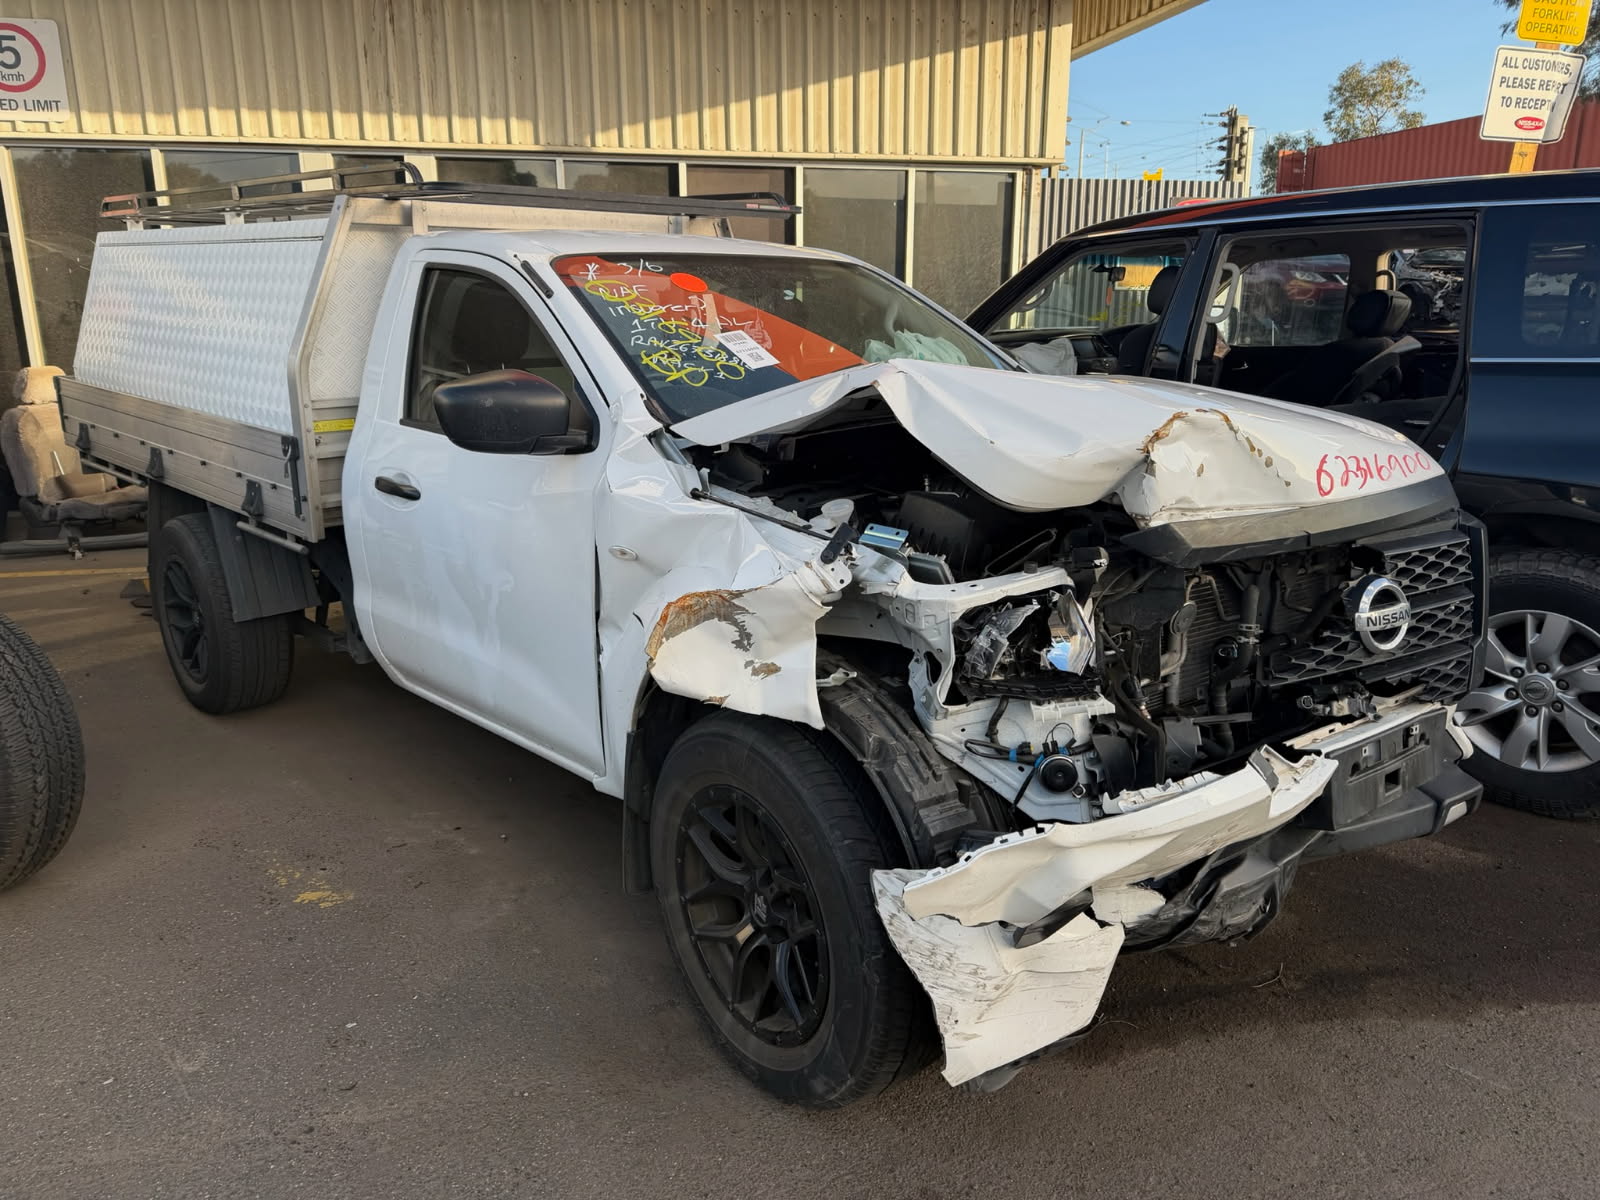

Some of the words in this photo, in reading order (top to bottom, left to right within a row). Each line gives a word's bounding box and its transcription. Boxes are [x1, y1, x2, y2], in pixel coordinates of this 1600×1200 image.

[1525, 21, 1580, 36] OPERATING
[1502, 56, 1520, 70] ALL
[1521, 58, 1572, 77] CUSTOMRS,
[1500, 76, 1537, 91] PLEASE
[1538, 79, 1568, 95] REPRT
[23, 99, 61, 112] LIMIT
[1501, 96, 1513, 108] TO
[1316, 451, 1431, 497] 62316900
[1367, 608, 1410, 627] NISSAN
